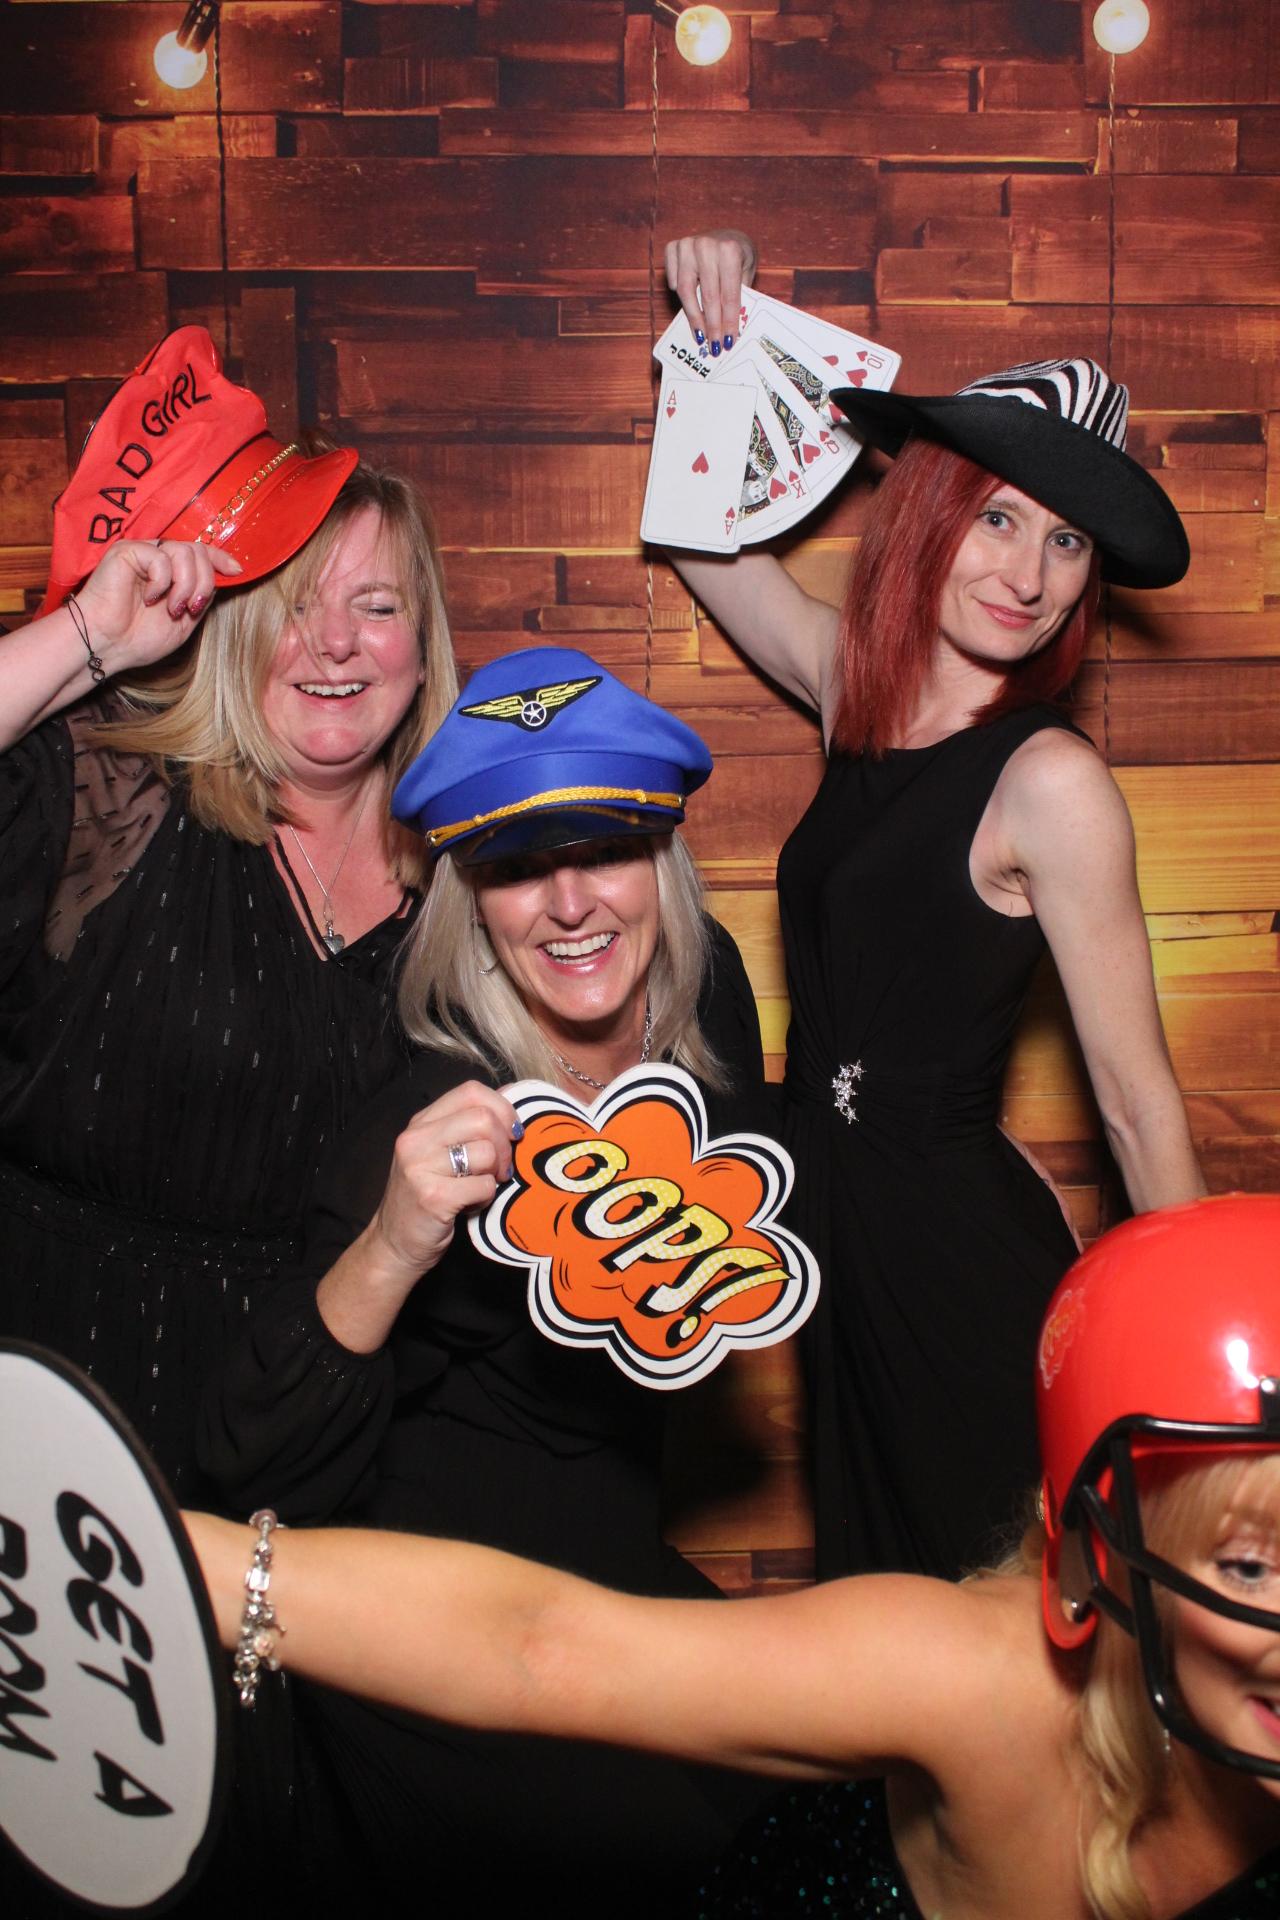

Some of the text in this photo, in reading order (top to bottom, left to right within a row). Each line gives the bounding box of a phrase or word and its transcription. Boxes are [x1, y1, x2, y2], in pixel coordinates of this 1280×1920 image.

[668, 342, 711, 379] JOKER
[867, 353, 886, 370] 10
[667, 389, 678, 405] A
[87, 362, 213, 545] BAD GIRL
[824, 440, 840, 455] Q
[790, 479, 807, 499] K
[724, 520, 736, 537] A
[532, 1139, 797, 1348] OOPS!
[55, 1490, 175, 1818] GET A
